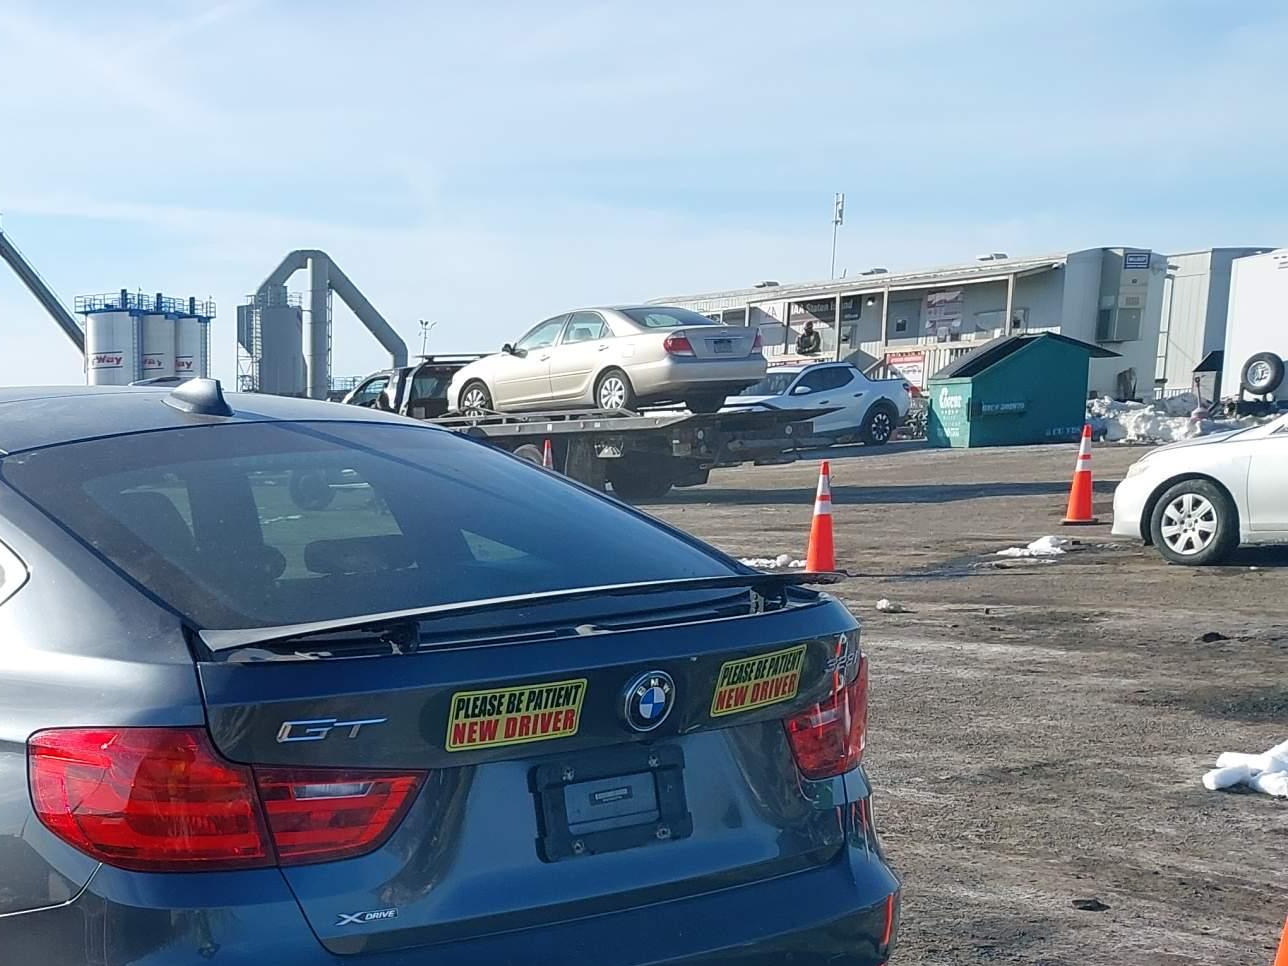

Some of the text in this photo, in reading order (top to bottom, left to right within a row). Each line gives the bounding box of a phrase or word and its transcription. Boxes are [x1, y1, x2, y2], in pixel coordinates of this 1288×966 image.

[720, 650, 804, 687] PLEASE BE PATIENT
[455, 685, 581, 720] PLEASE BE PATIENT
[636, 678, 671, 697] BMW
[715, 672, 798, 711] NEW DRIVER
[276, 718, 387, 743] GT
[452, 708, 576, 745] NEW DRIVER
